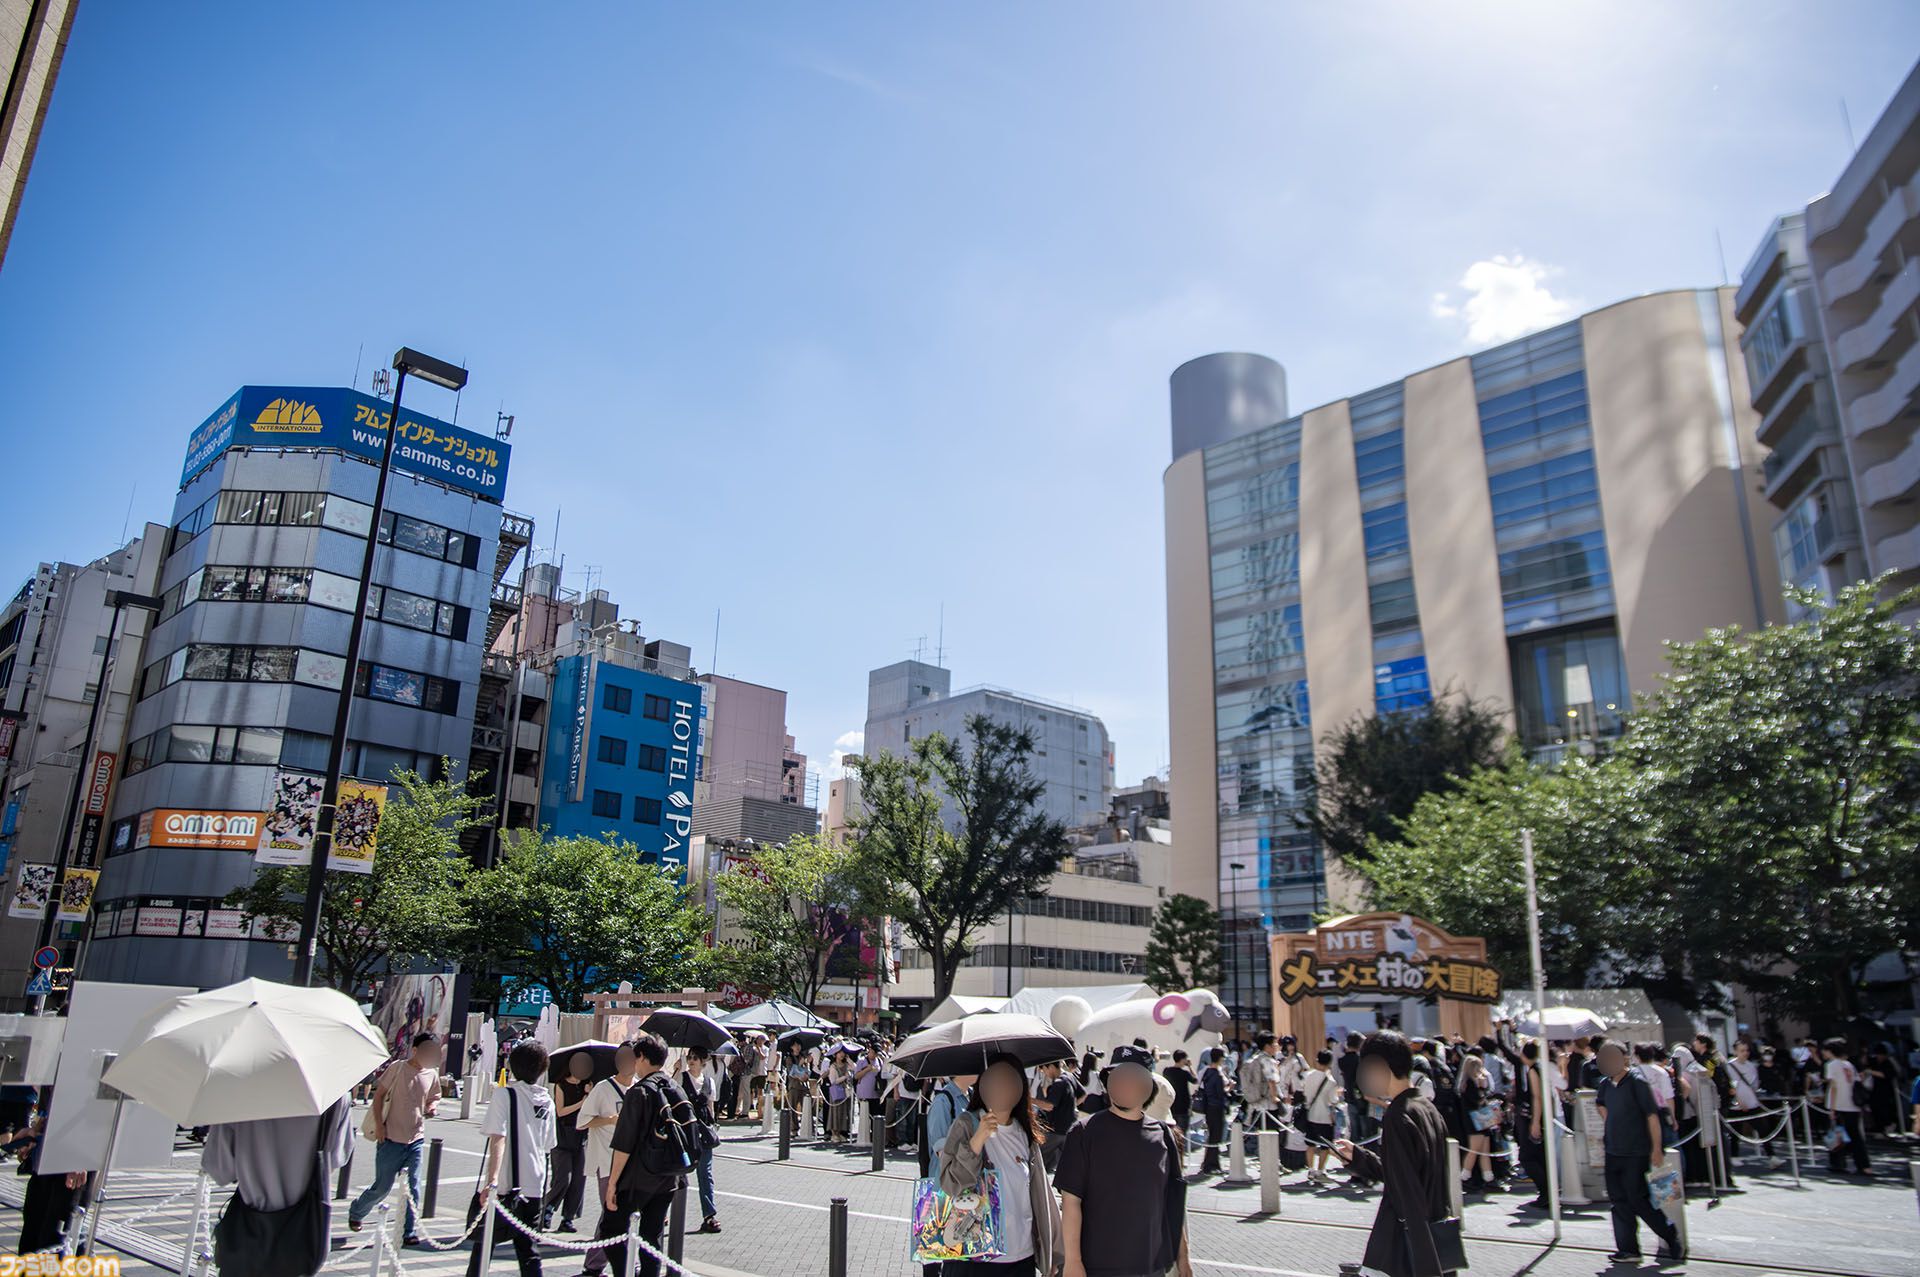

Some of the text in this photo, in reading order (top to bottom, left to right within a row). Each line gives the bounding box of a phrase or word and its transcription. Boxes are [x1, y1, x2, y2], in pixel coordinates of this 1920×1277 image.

[354, 404, 498, 468] アムスインターナショナル
[579, 665, 589, 701] HOTEL
[89, 756, 112, 812] amiami
[662, 701, 692, 885] HOTEL PAR
[165, 813, 257, 837] amiami
[1326, 930, 1375, 950] NTE
